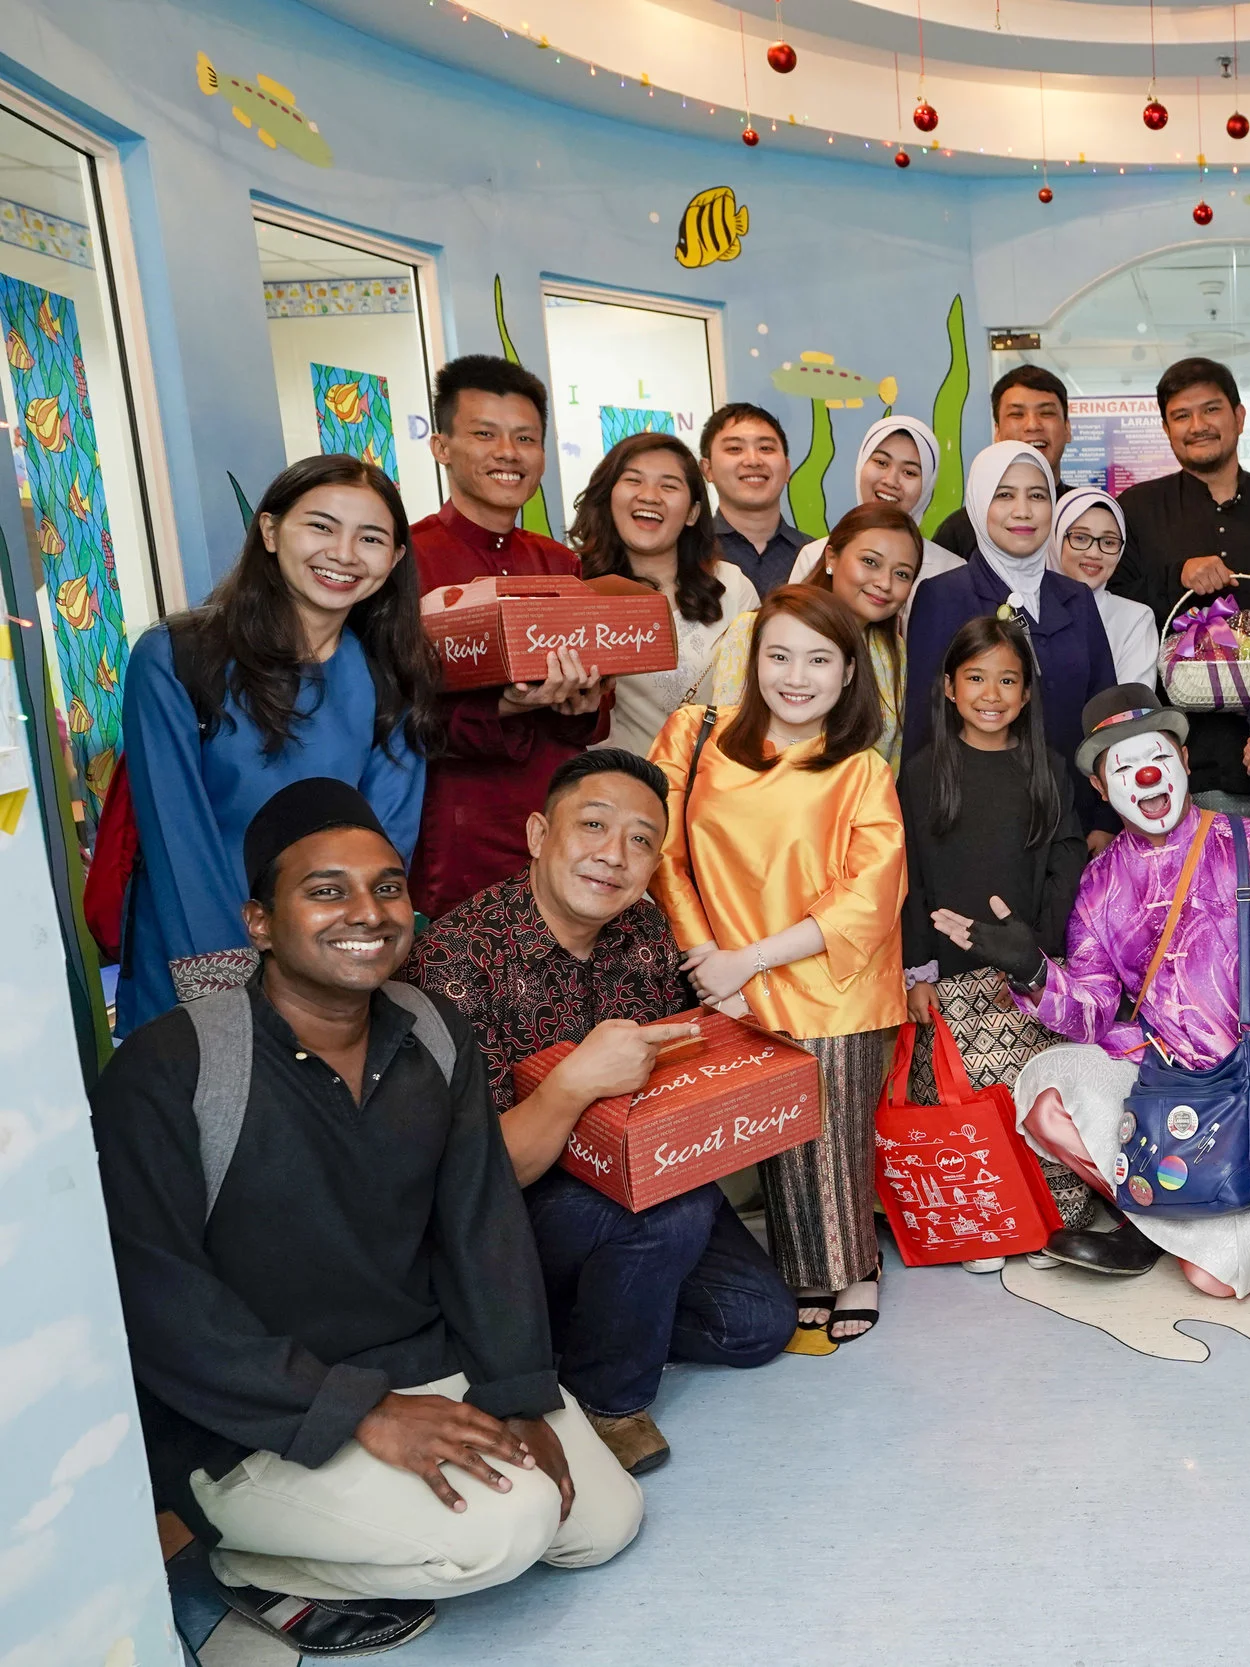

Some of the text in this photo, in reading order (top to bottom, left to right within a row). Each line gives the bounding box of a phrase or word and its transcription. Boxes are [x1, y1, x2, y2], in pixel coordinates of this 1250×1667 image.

[1069, 401, 1159, 414] ERINGATAN
[526, 623, 590, 653] Secret
[654, 1125, 727, 1176] Secret
